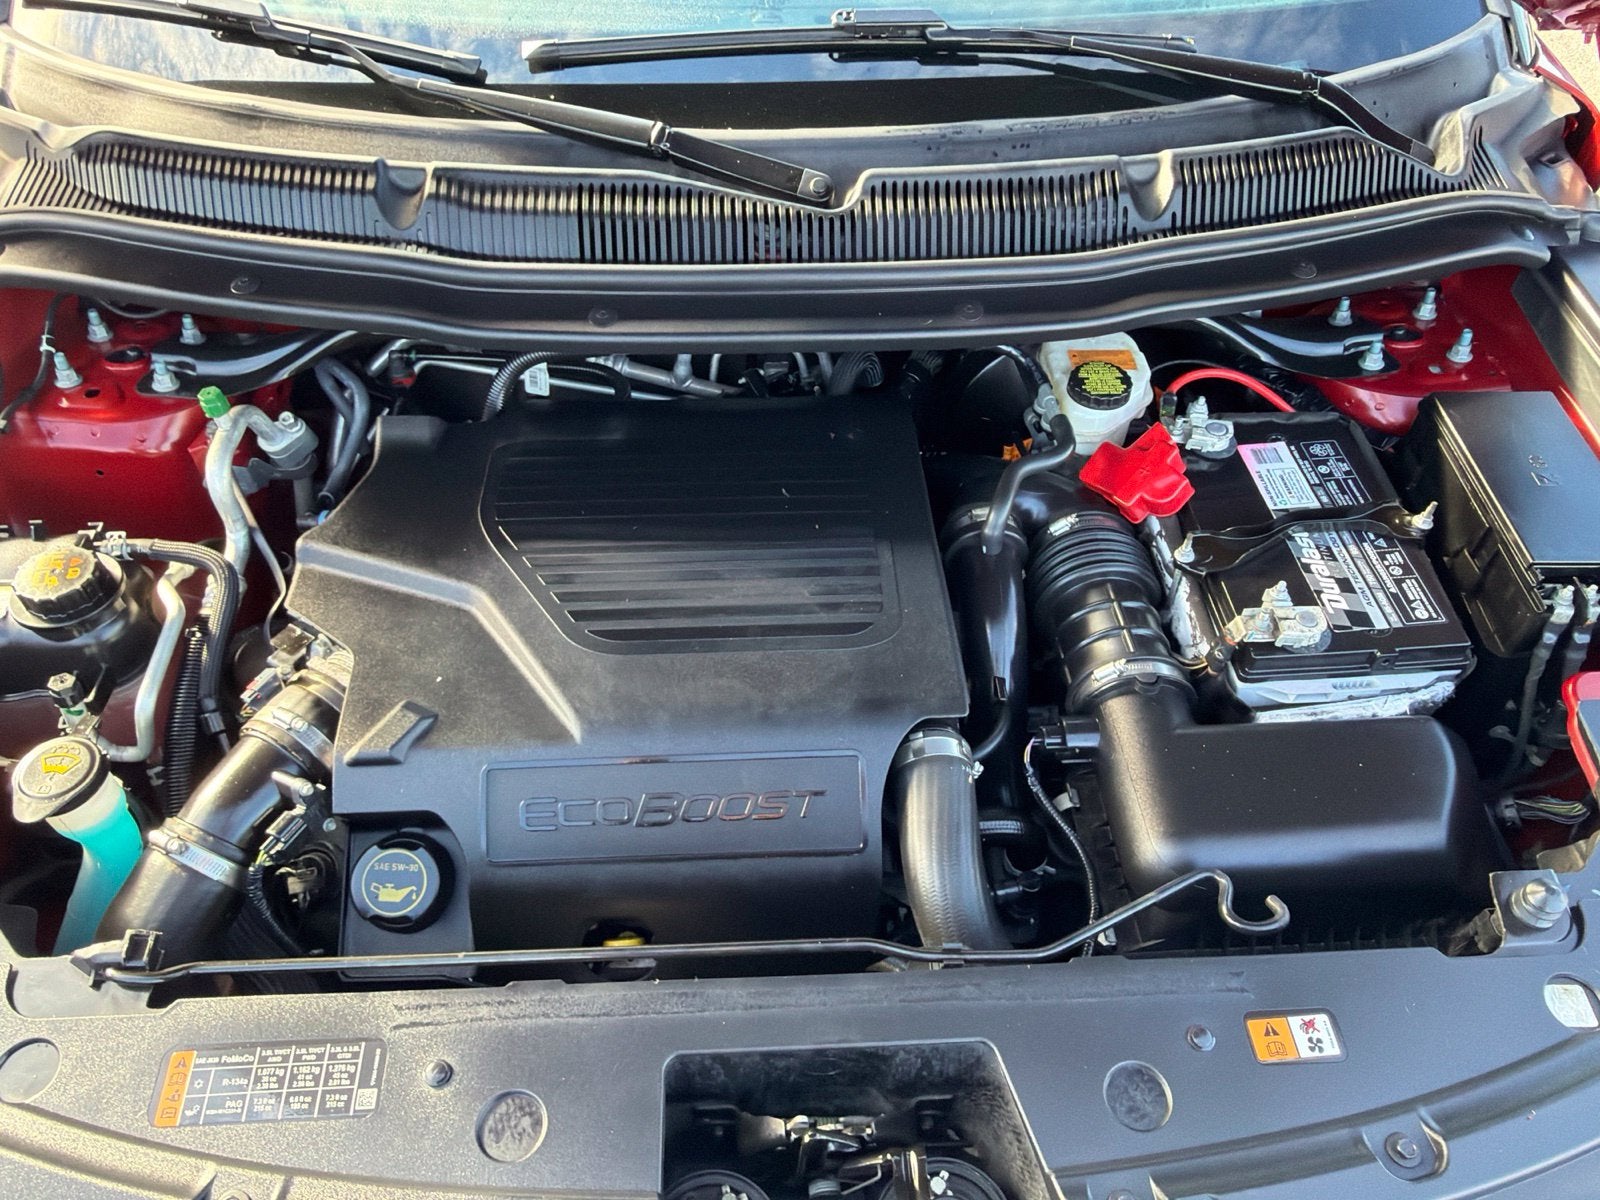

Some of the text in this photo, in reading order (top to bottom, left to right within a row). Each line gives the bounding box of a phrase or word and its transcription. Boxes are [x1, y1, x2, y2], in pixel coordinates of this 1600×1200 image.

[1326, 532, 1361, 584] TECHNOLOGY
[1357, 586, 1374, 607] AGM
[373, 862, 419, 872] SAE 5W-30
[221, 1054, 255, 1064] FoMoCo
[275, 1067, 285, 1077] kg
[311, 1066, 321, 1075] kg
[347, 1064, 356, 1073] kg
[222, 1077, 249, 1086] R-134a
[225, 1100, 243, 1108] PAG
